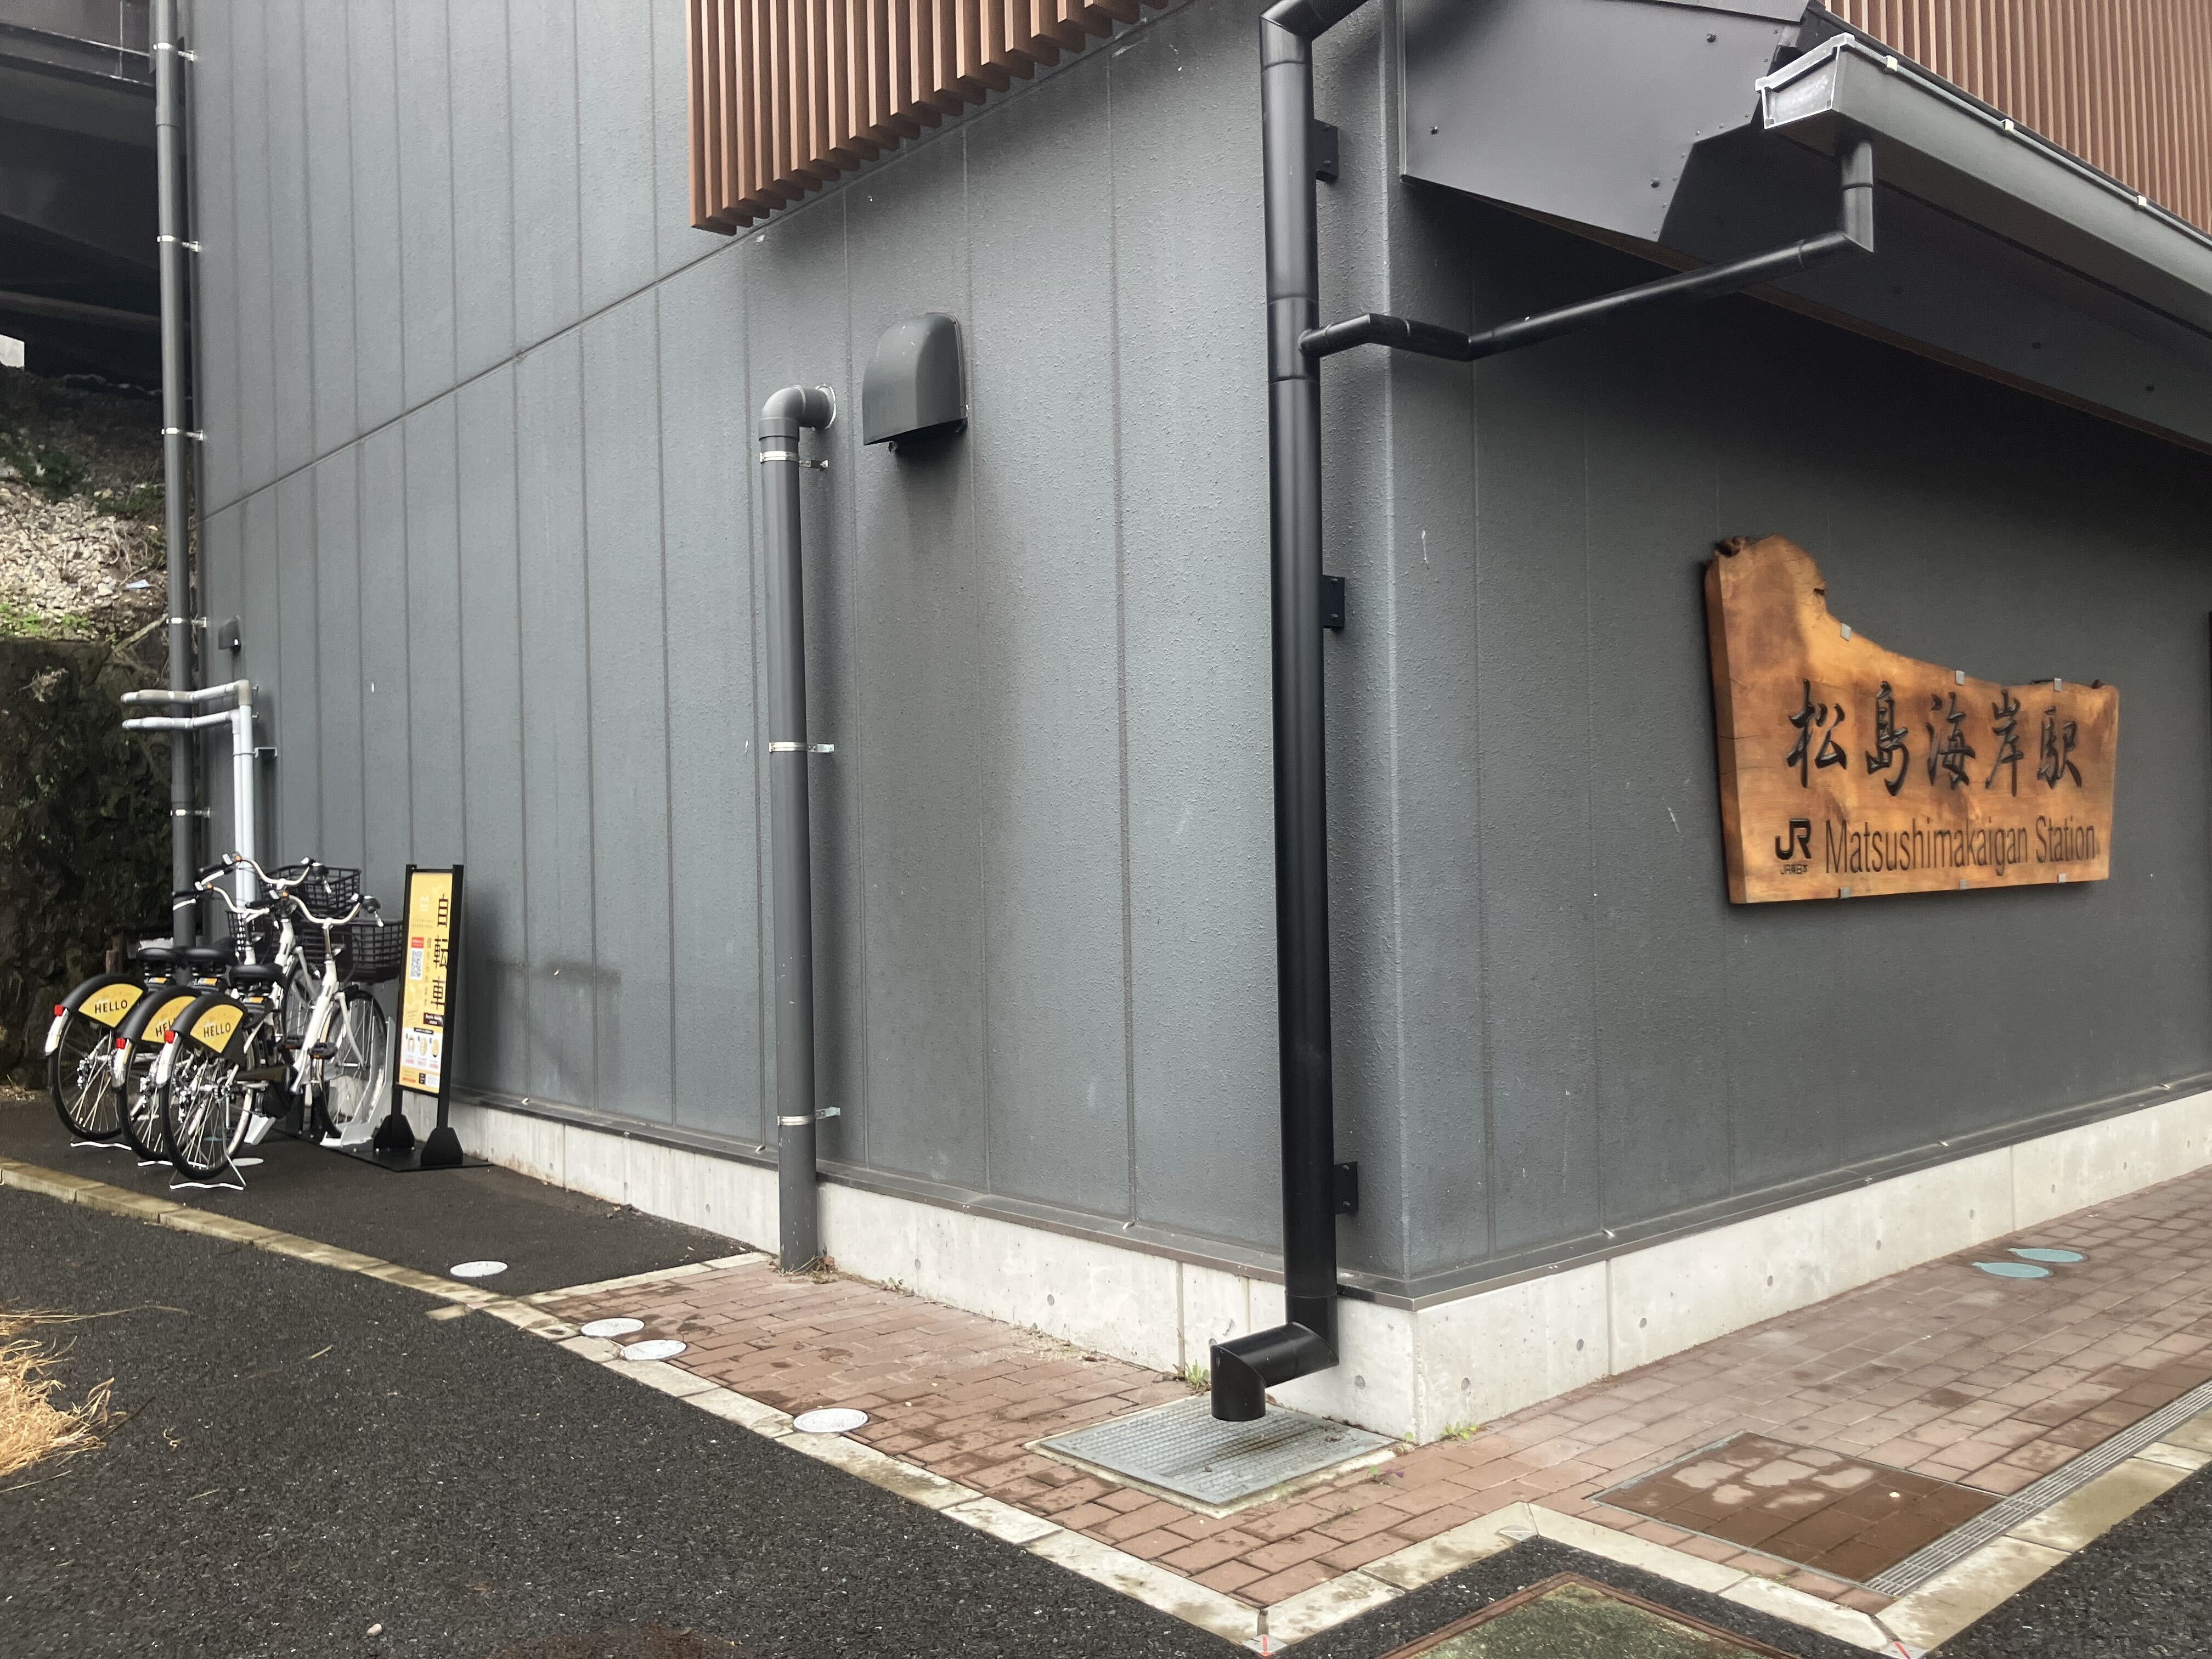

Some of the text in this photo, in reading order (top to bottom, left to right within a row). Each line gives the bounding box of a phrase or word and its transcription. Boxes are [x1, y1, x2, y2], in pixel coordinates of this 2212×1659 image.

[1786, 678, 2082, 797] 松島海岸駅
[1775, 818, 1812, 860] JR
[1825, 815, 2095, 877] Matsushimakaigan Station
[431, 893, 449, 1011] 自転車
[95, 1000, 128, 1014] HELLO
[204, 1022, 231, 1038] HELLO
